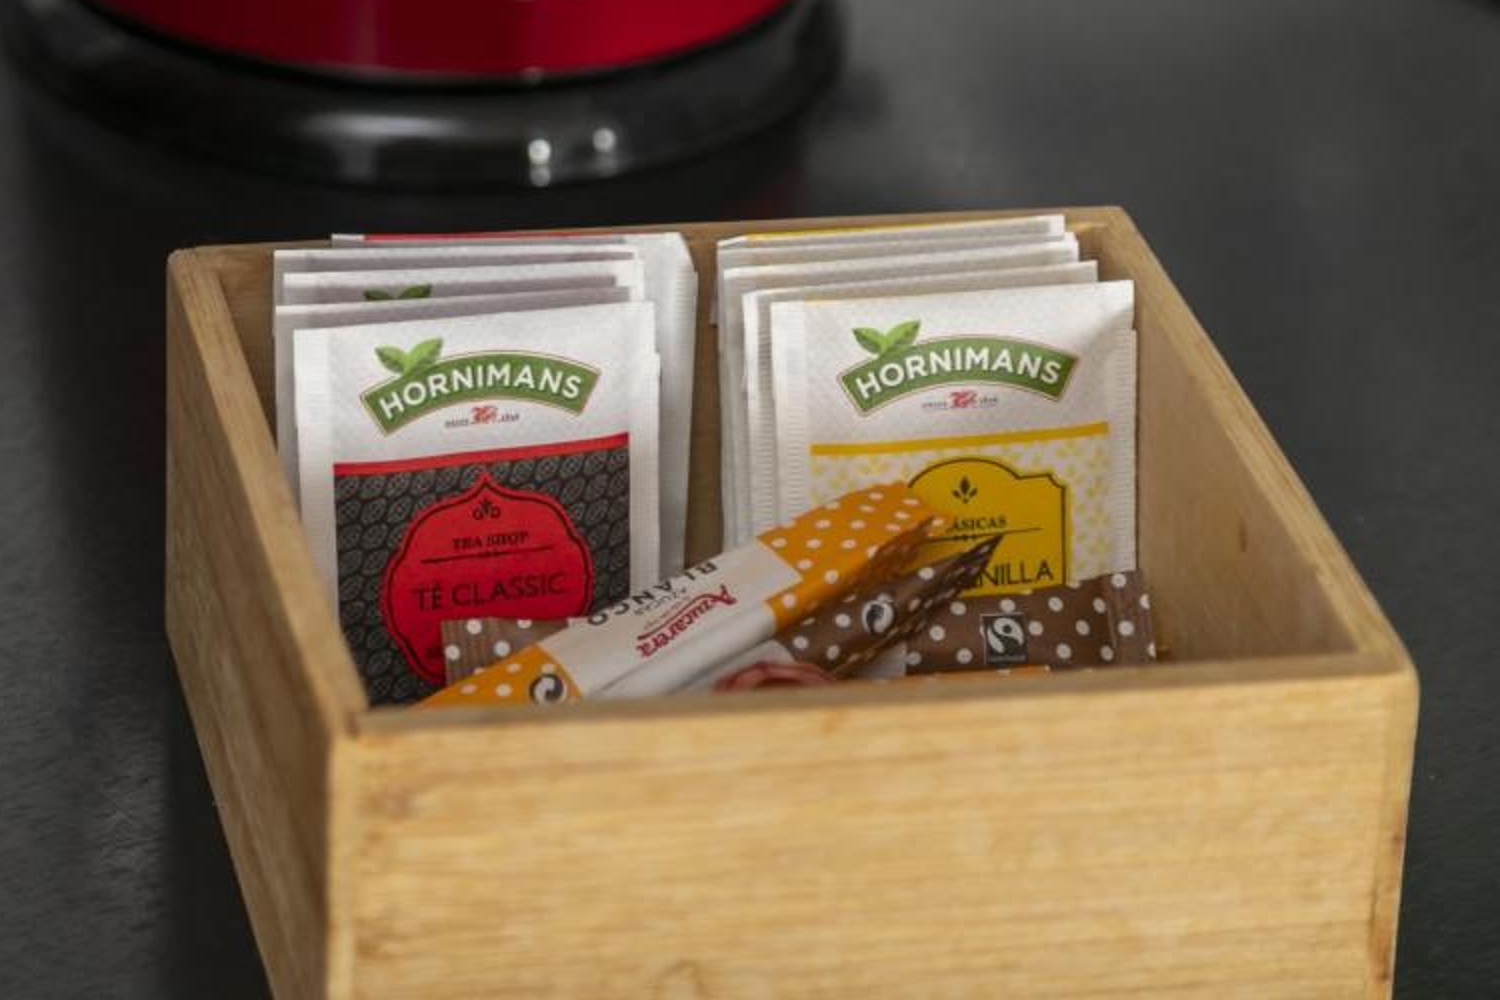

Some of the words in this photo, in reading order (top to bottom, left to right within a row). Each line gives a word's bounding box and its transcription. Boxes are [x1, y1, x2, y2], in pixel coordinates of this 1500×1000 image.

[378, 363, 582, 419] HORNIMANS
[856, 347, 1062, 399] HORNIMANS
[452, 537, 483, 549] TEA
[451, 571, 568, 607] CLASSIC
[979, 559, 1054, 588] NILLA
[636, 584, 738, 658] Azucarera
